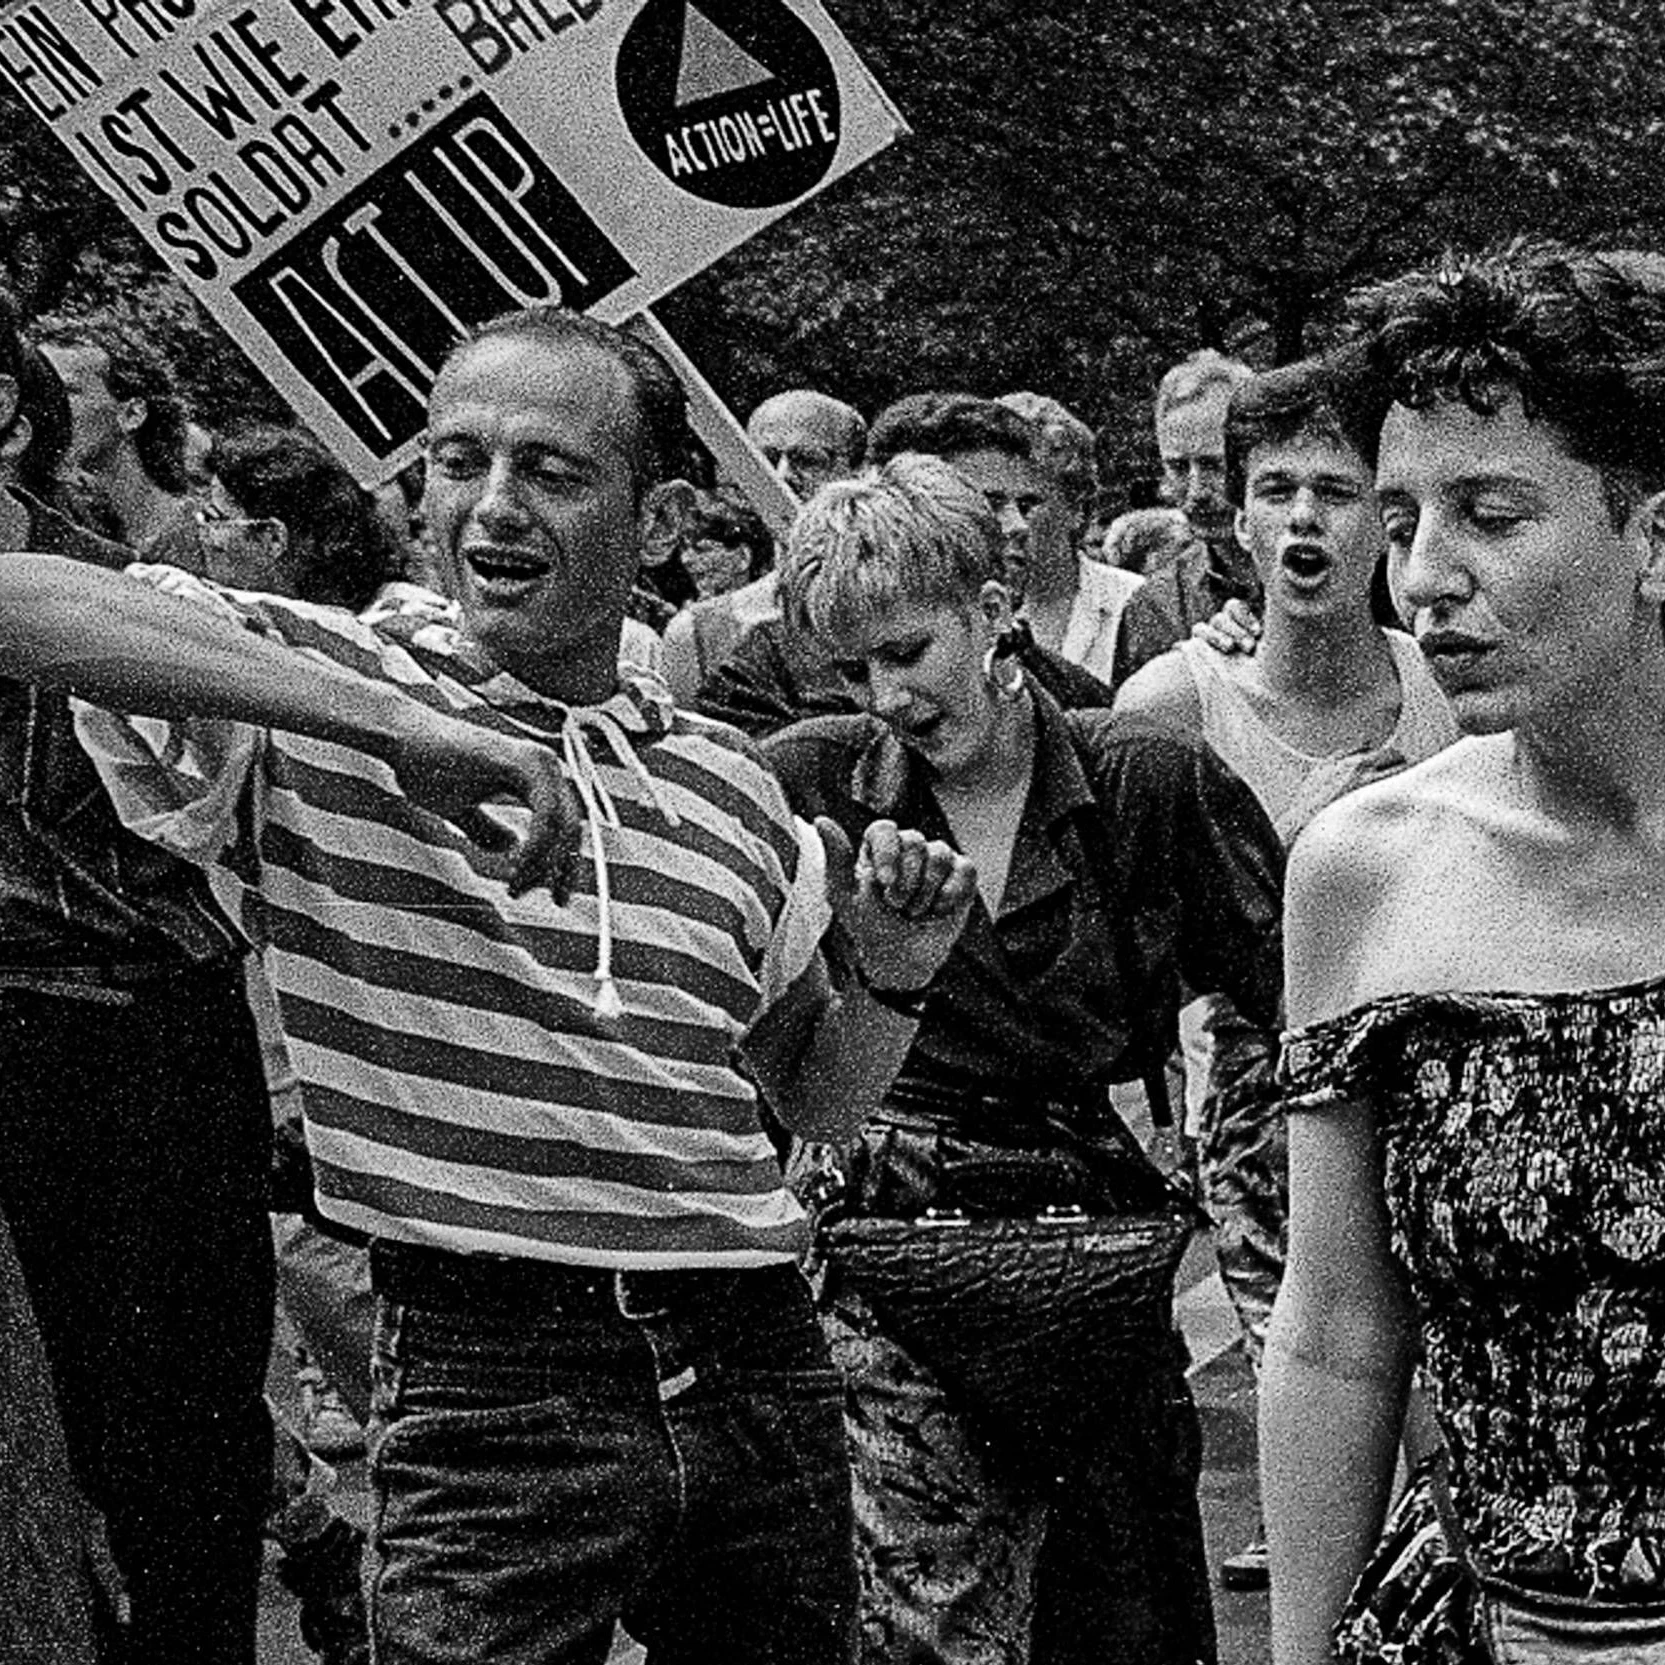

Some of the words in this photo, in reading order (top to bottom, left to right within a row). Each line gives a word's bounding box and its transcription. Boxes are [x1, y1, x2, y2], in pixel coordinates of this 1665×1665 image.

[75, 87, 197, 212] IST
[158, 9, 310, 141] WIE
[156, 79, 372, 281] SOLDAT
[269, 201, 470, 441] ACT
[403, 116, 590, 309] UP
